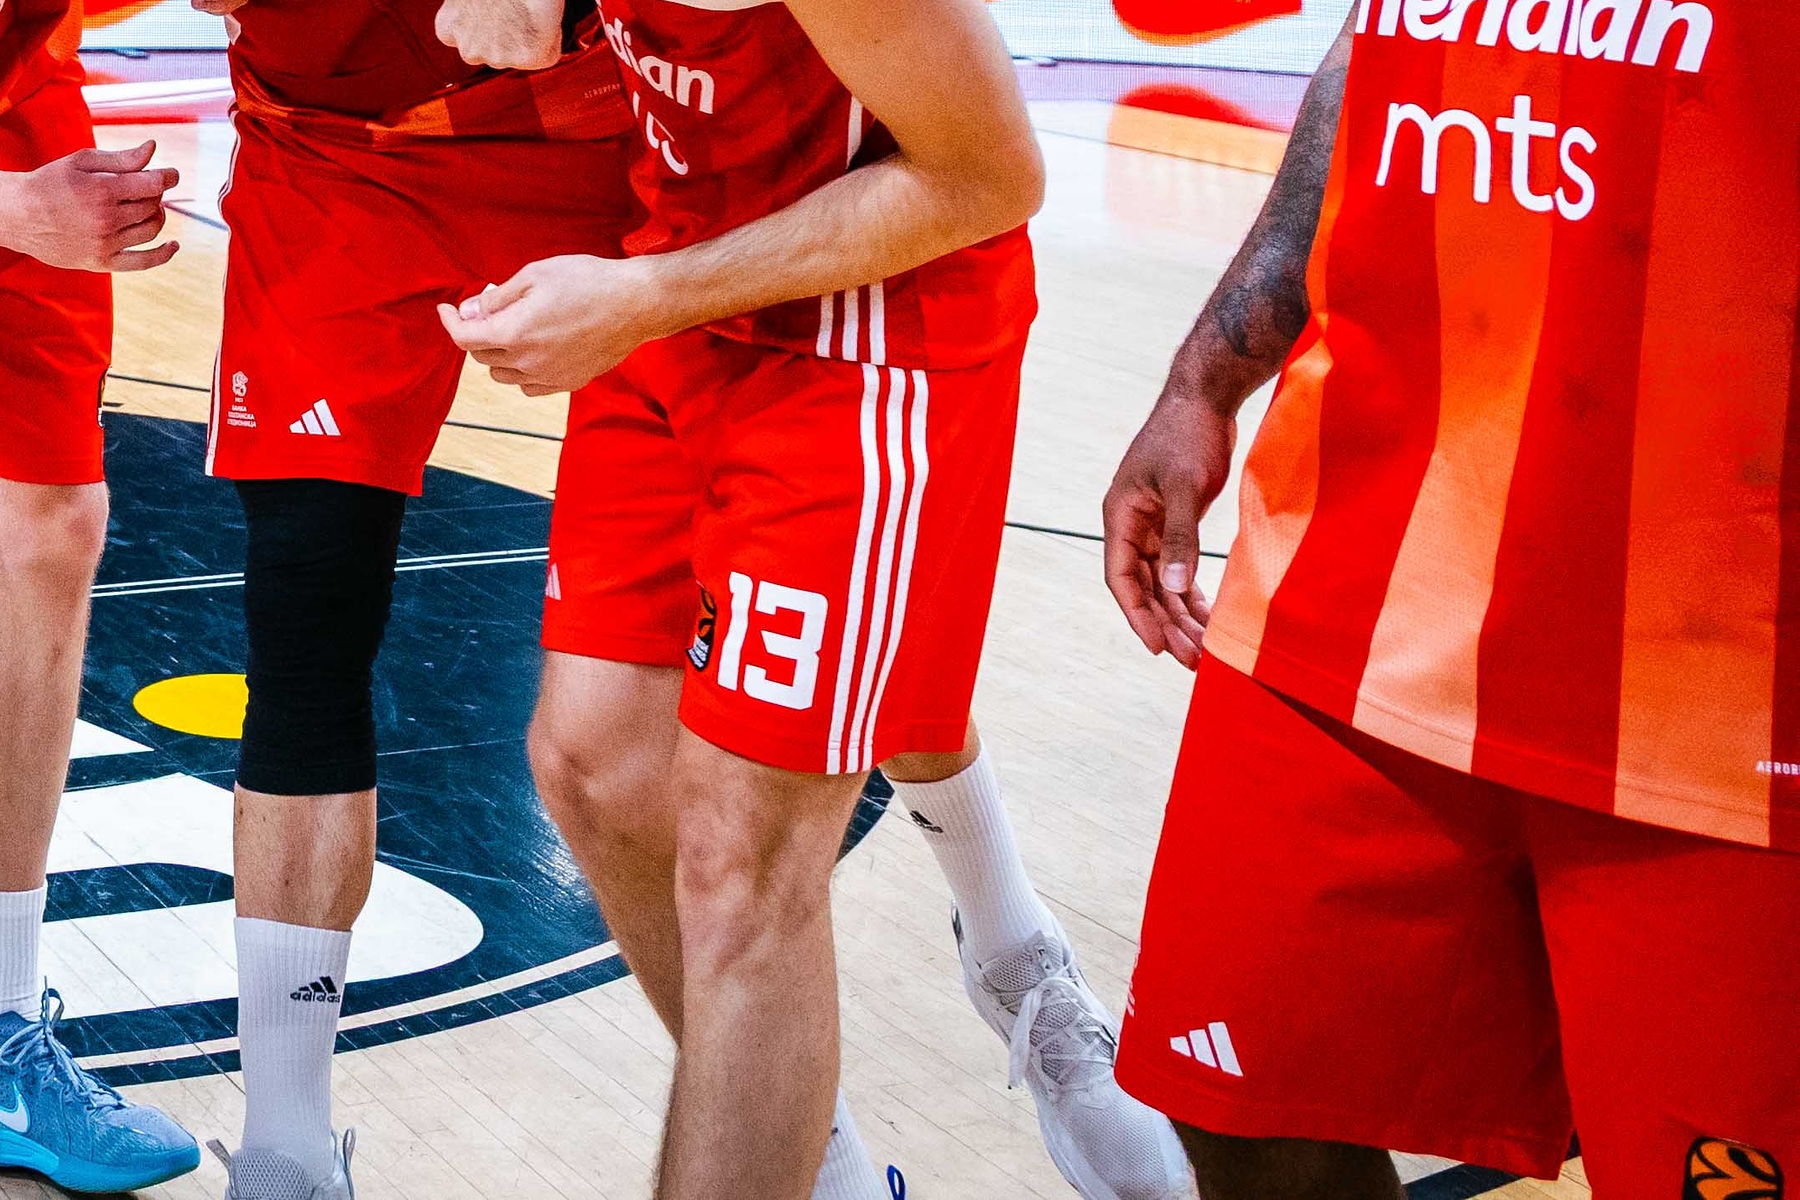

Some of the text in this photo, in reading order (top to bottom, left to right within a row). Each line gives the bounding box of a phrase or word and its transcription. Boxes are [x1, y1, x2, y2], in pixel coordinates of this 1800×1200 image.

[1375, 94, 1597, 221] mts
[717, 571, 829, 711] 13
[290, 990, 341, 1003] adidas
